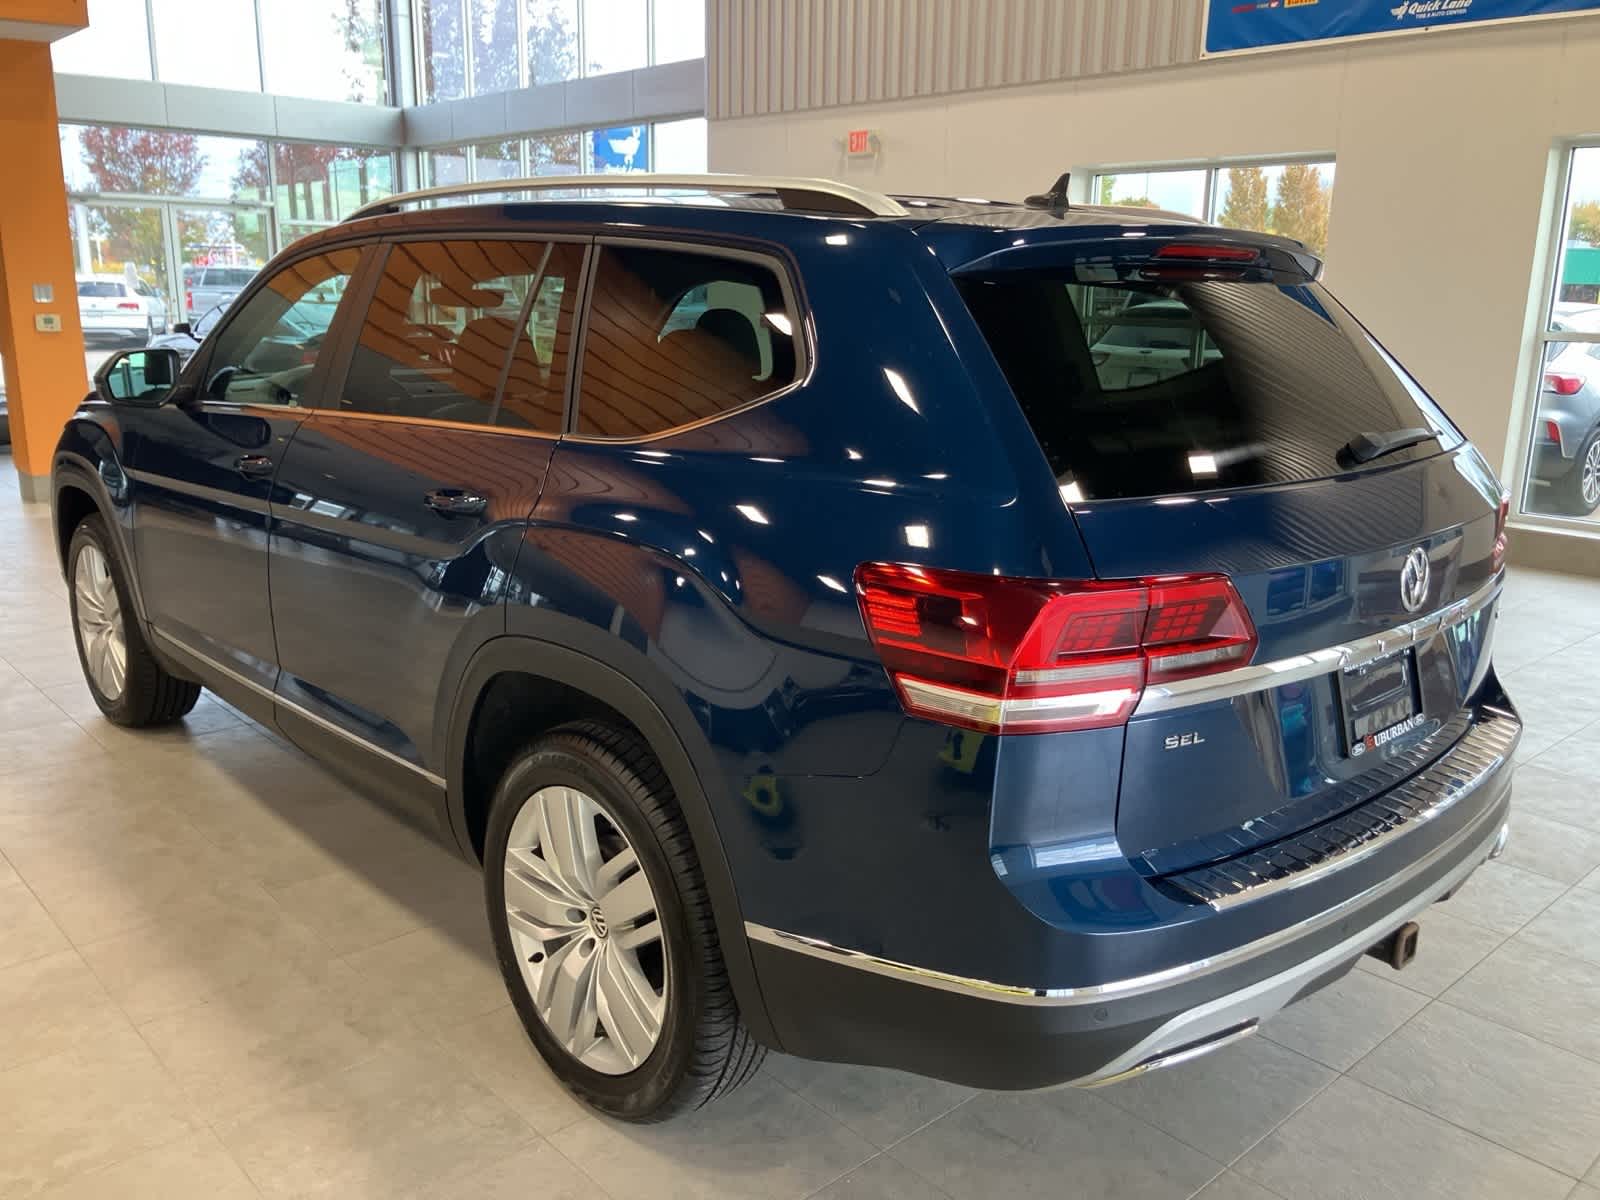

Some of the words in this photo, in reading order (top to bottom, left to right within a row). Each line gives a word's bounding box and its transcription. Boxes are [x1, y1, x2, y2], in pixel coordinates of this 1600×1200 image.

[1408, 0, 1442, 15] Quick
[849, 131, 868, 152] EXIT
[1164, 731, 1205, 749] SEL
